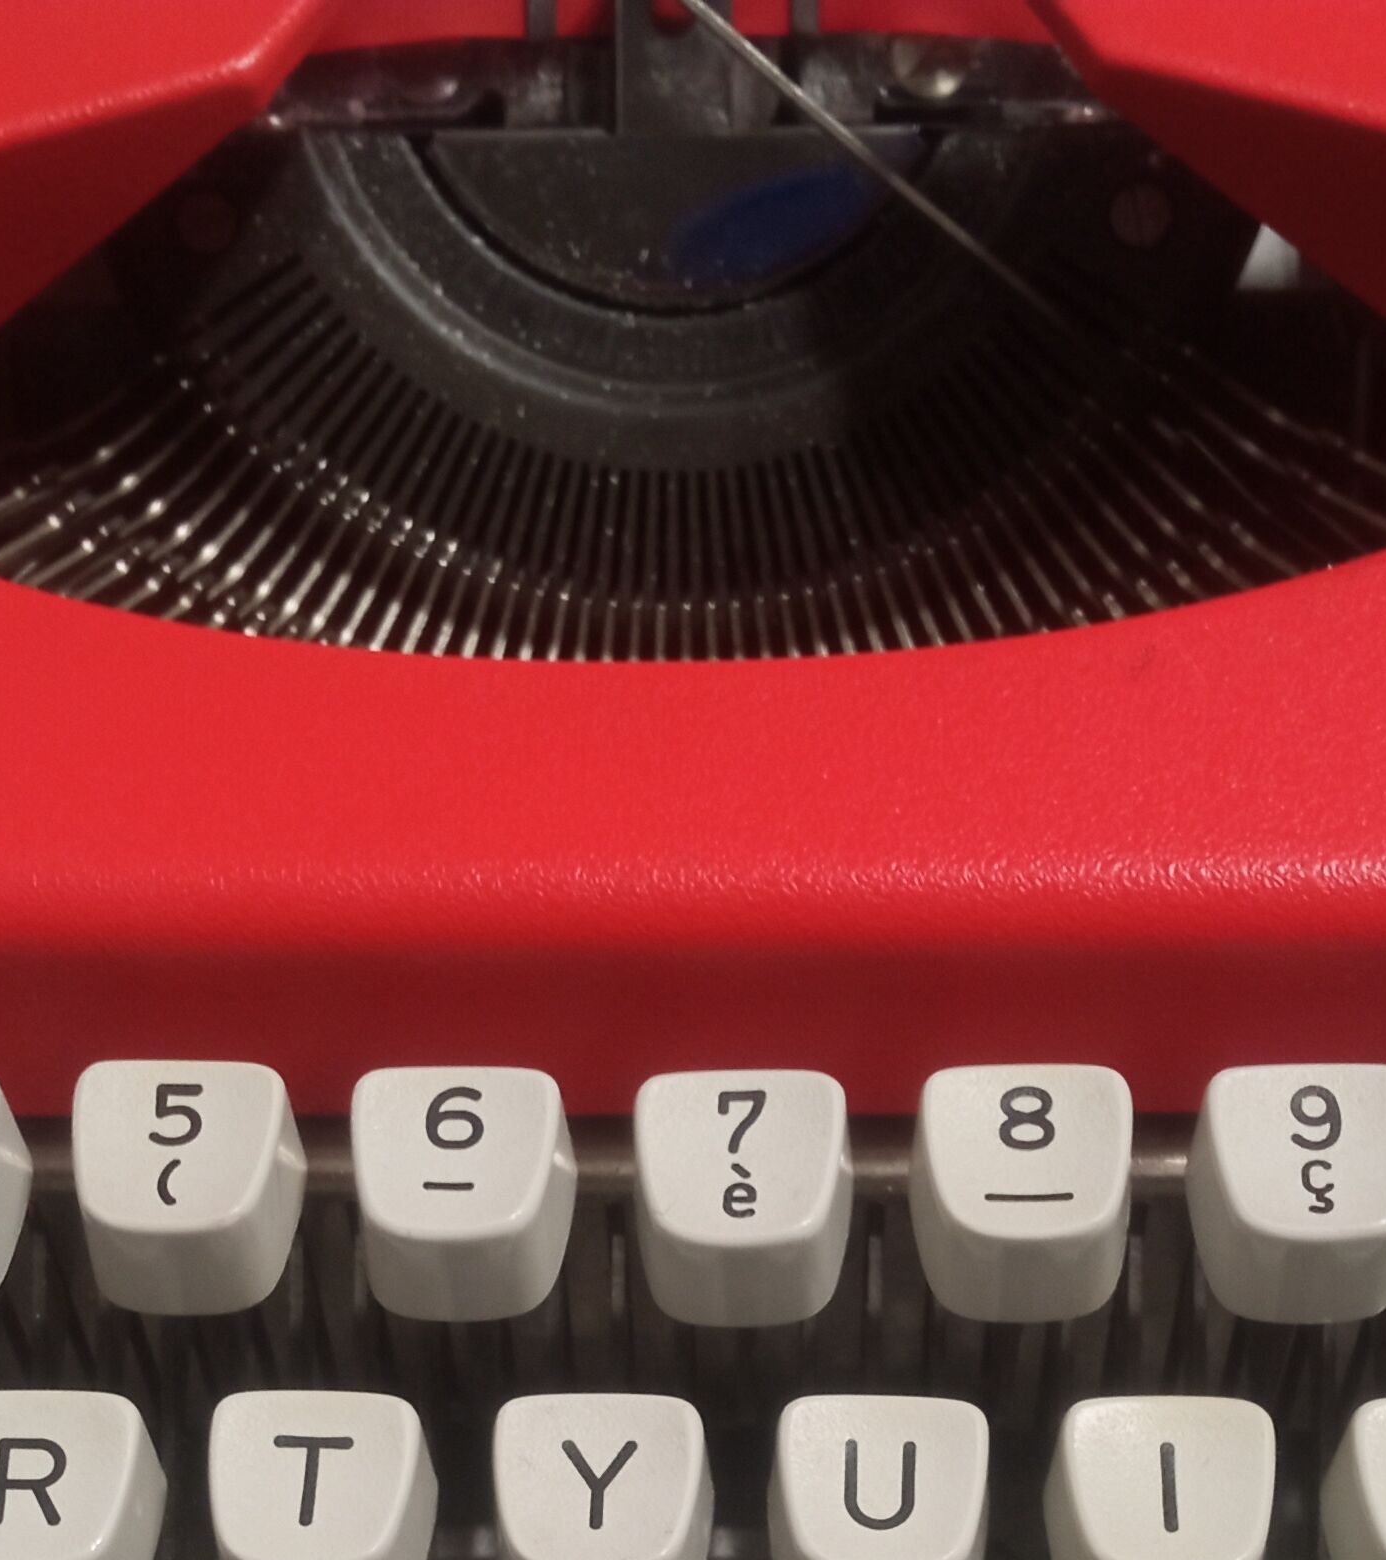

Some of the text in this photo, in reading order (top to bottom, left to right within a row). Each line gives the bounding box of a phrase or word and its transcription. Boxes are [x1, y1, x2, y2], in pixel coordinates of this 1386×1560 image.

[147, 1082, 205, 1148] 5
[424, 1085, 486, 1152] 6
[716, 1088, 768, 1156] 7
[997, 1084, 1057, 1152] 8
[1288, 1083, 1343, 1152] 9
[721, 1161, 759, 1220] è
[1300, 1158, 1336, 1216] ç
[272, 1433, 356, 1528] T
[560, 1438, 639, 1532] Y
[842, 1437, 918, 1532] U
